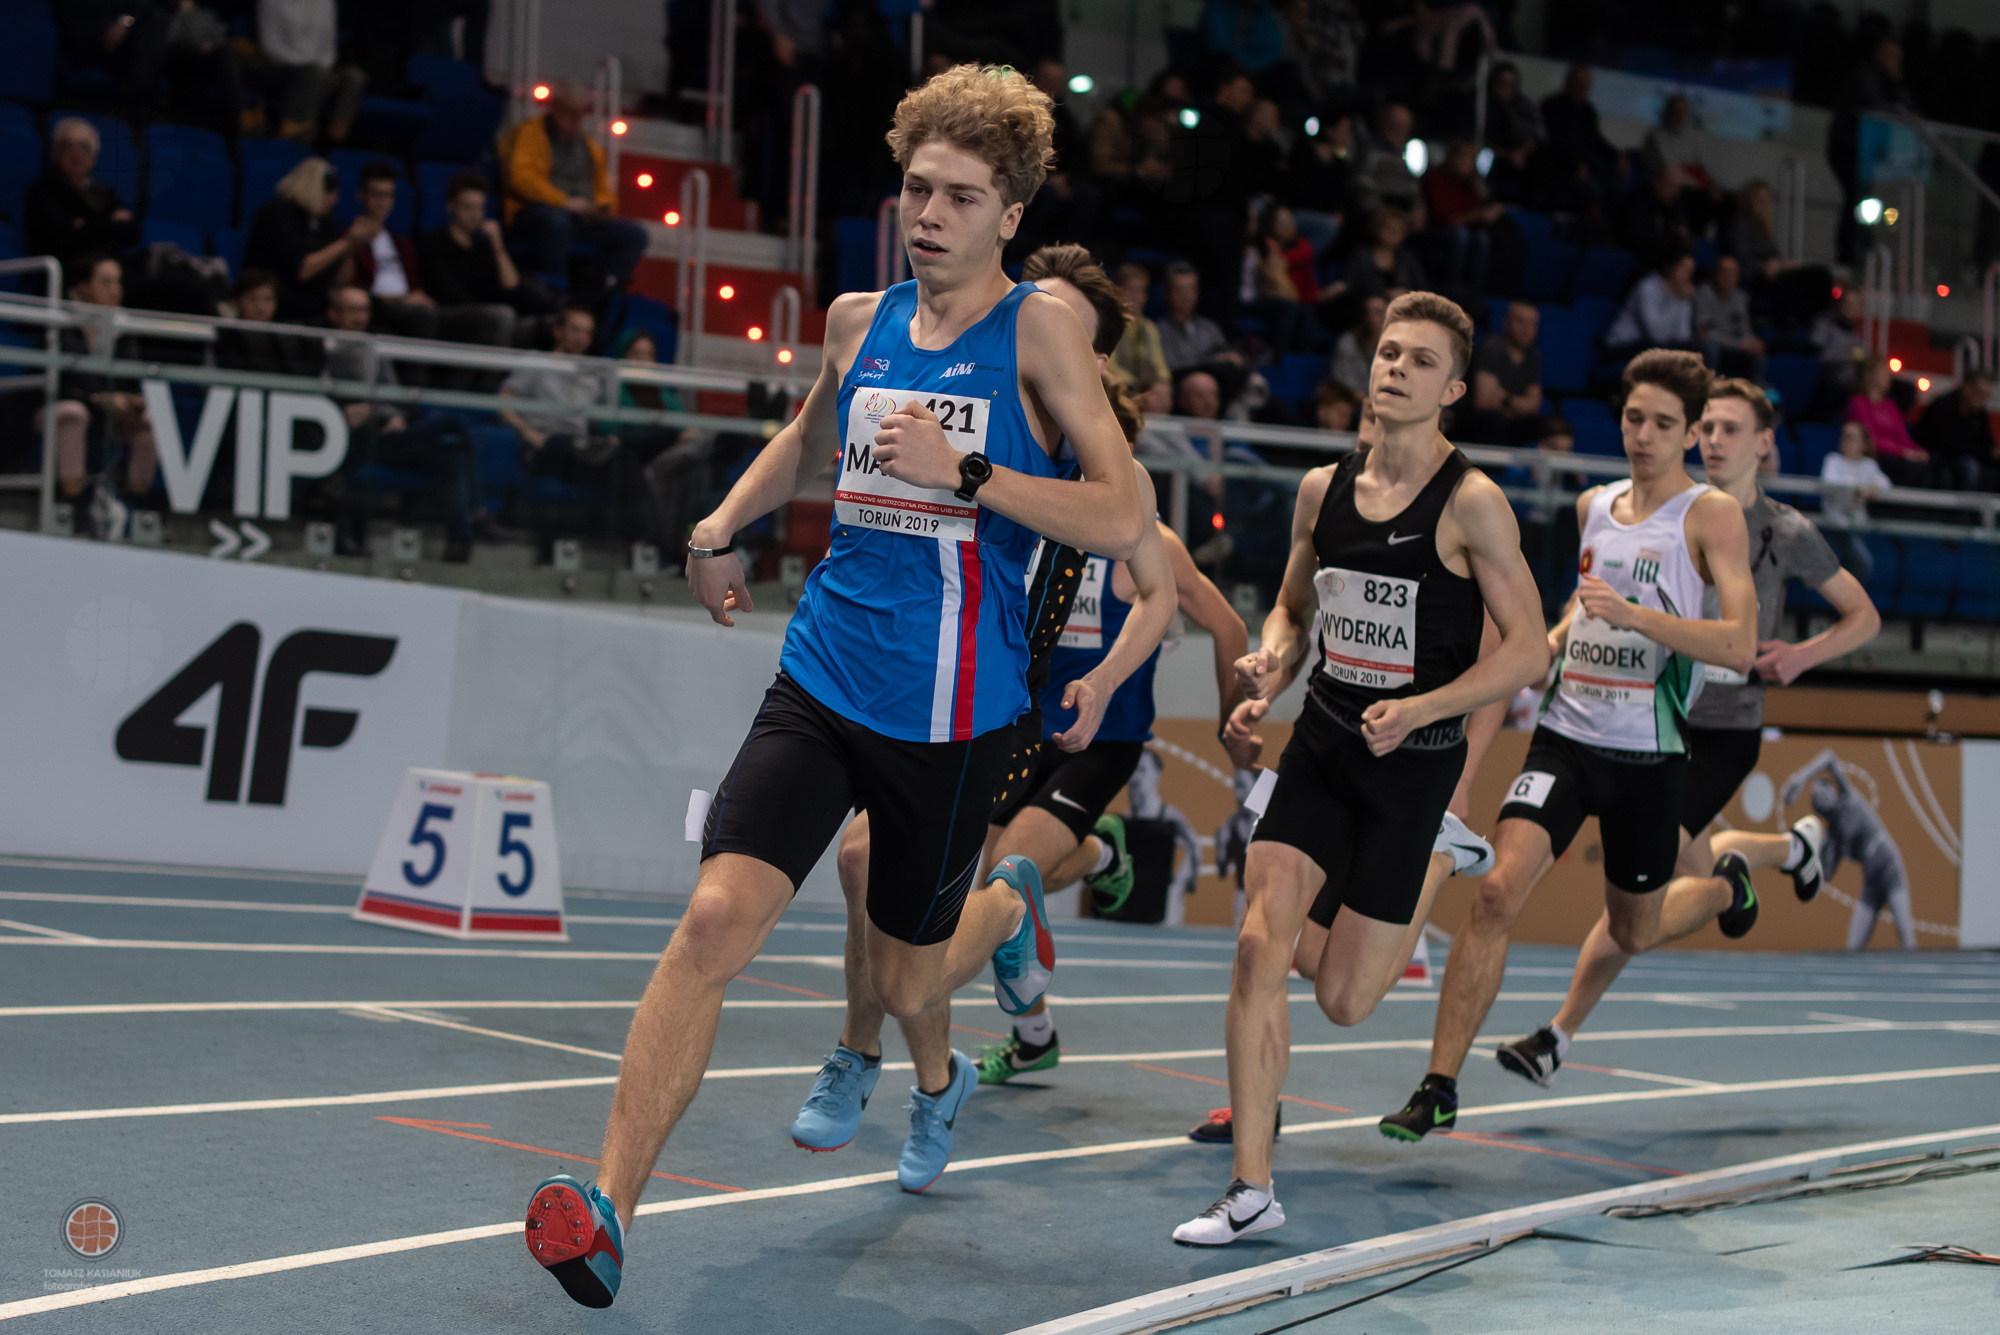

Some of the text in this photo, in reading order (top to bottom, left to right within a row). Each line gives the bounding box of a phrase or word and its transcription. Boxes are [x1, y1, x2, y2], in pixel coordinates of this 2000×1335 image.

[142, 378, 350, 520] VIP
[846, 442, 888, 477] MA
[853, 494, 876, 503] HALOWE
[876, 498, 917, 508] MISTRZOSTWA
[917, 503, 940, 511] POLSKI
[858, 508, 940, 533] TORUŃ 2019
[1363, 578, 1409, 609] 823
[1320, 609, 1409, 651] WYDERKA
[1569, 639, 1647, 670] GRODEK
[1330, 663, 1387, 686] TORUŃ 2019
[1604, 689, 1631, 701] 2019
[113, 619, 399, 807] 4F
[1412, 724, 1463, 747] NIKE
[1514, 775, 1535, 798] 6
[402, 802, 455, 887] 5
[496, 812, 535, 897] 5
